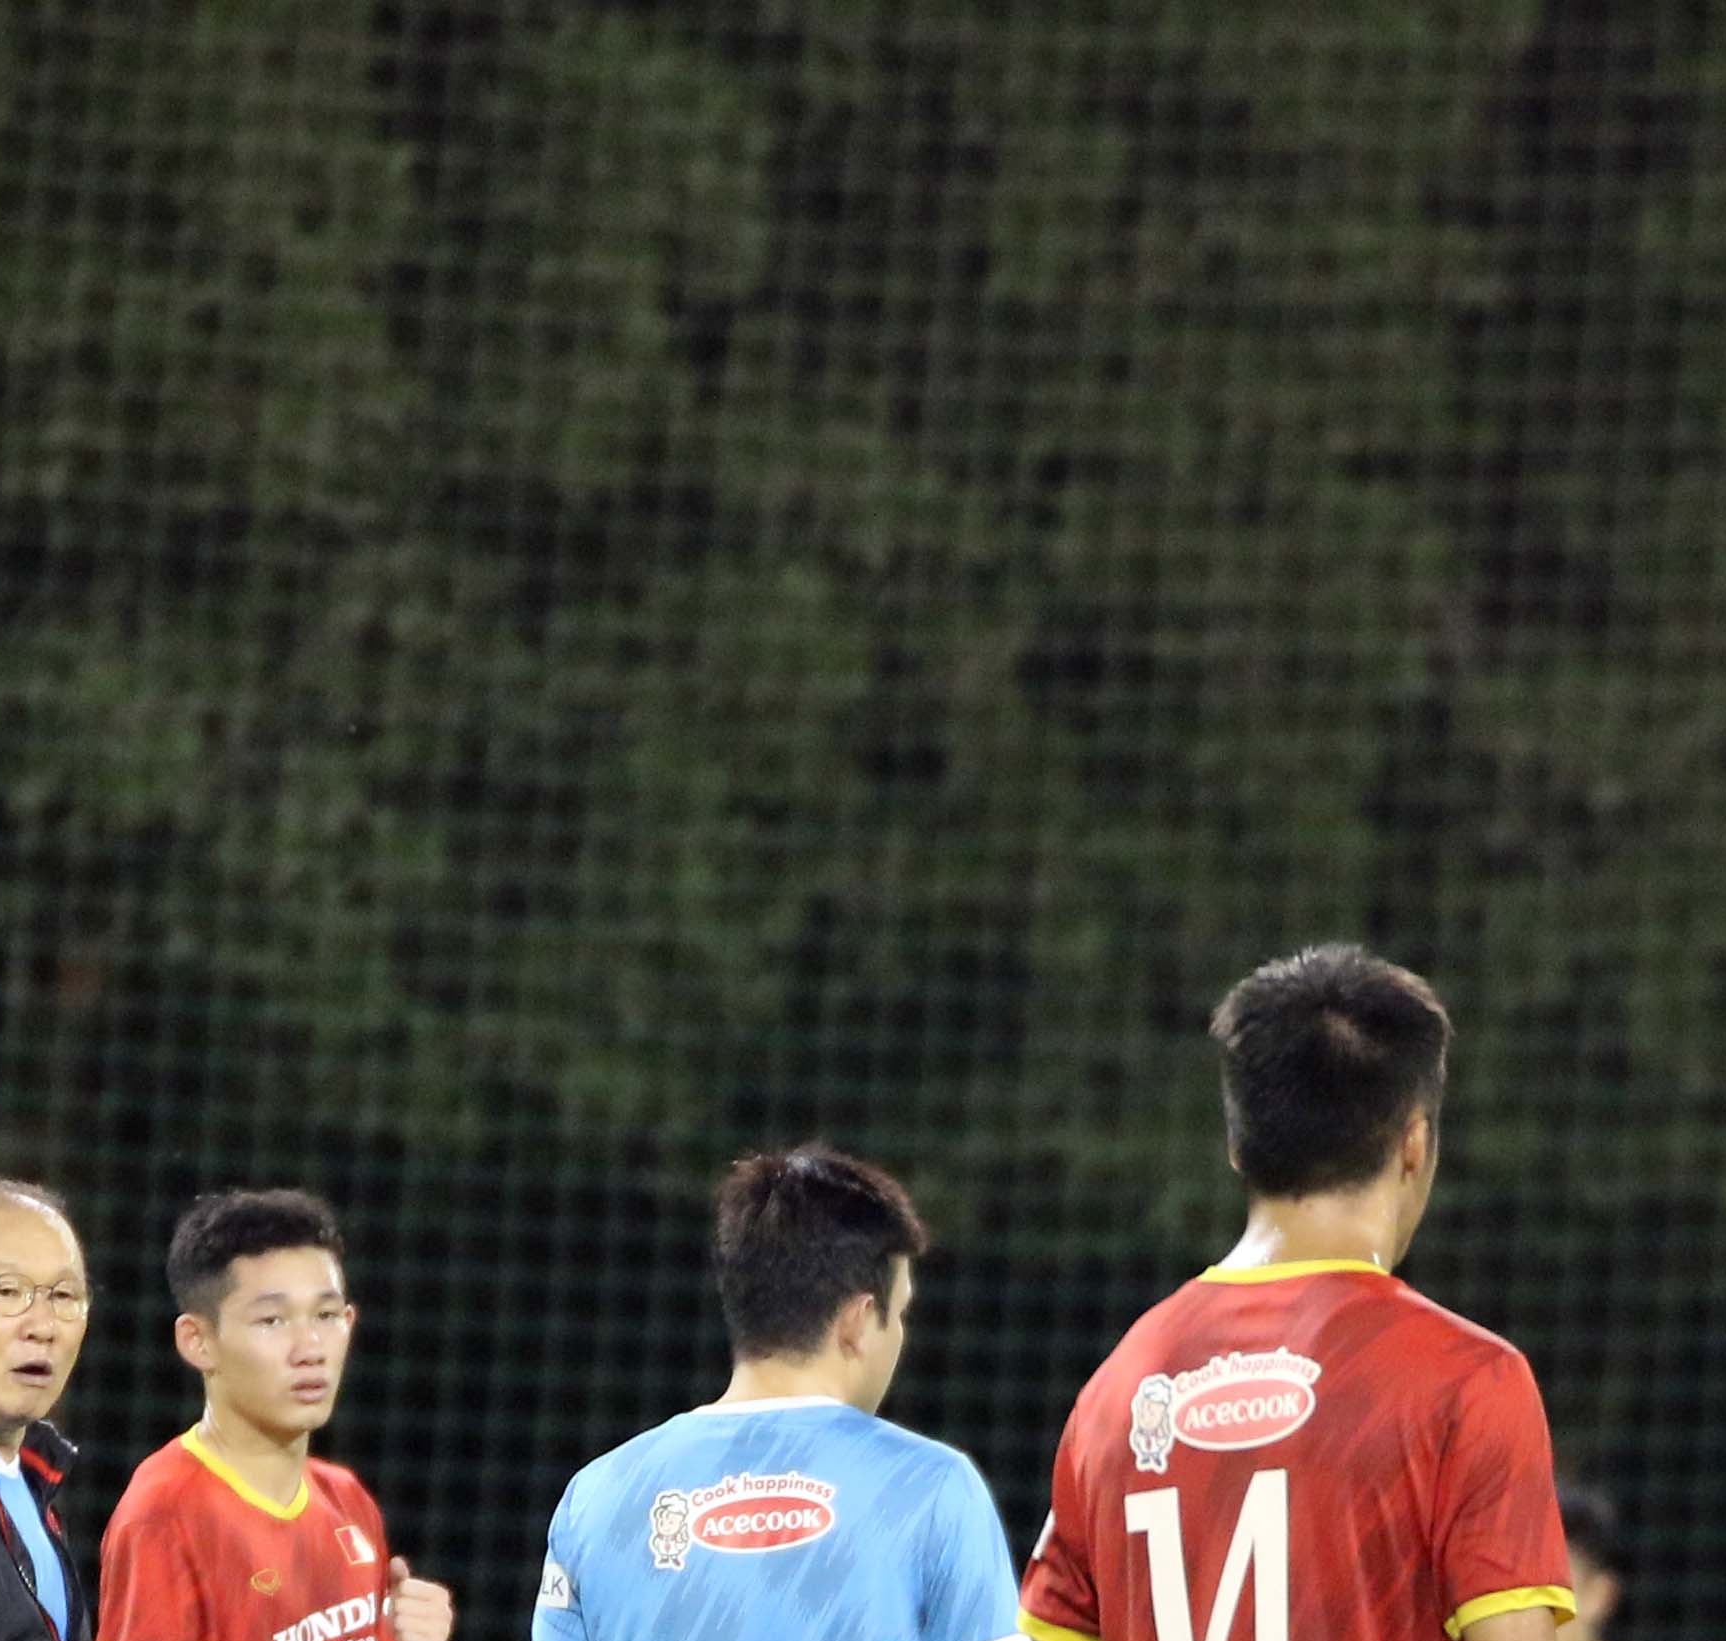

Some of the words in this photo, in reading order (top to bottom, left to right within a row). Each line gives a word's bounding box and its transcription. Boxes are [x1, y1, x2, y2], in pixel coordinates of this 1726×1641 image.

[1176, 1360, 1223, 1392] Cook
[1230, 1353, 1315, 1380] happiness
[692, 1479, 736, 1506] Cook
[743, 1474, 832, 1499] happiness
